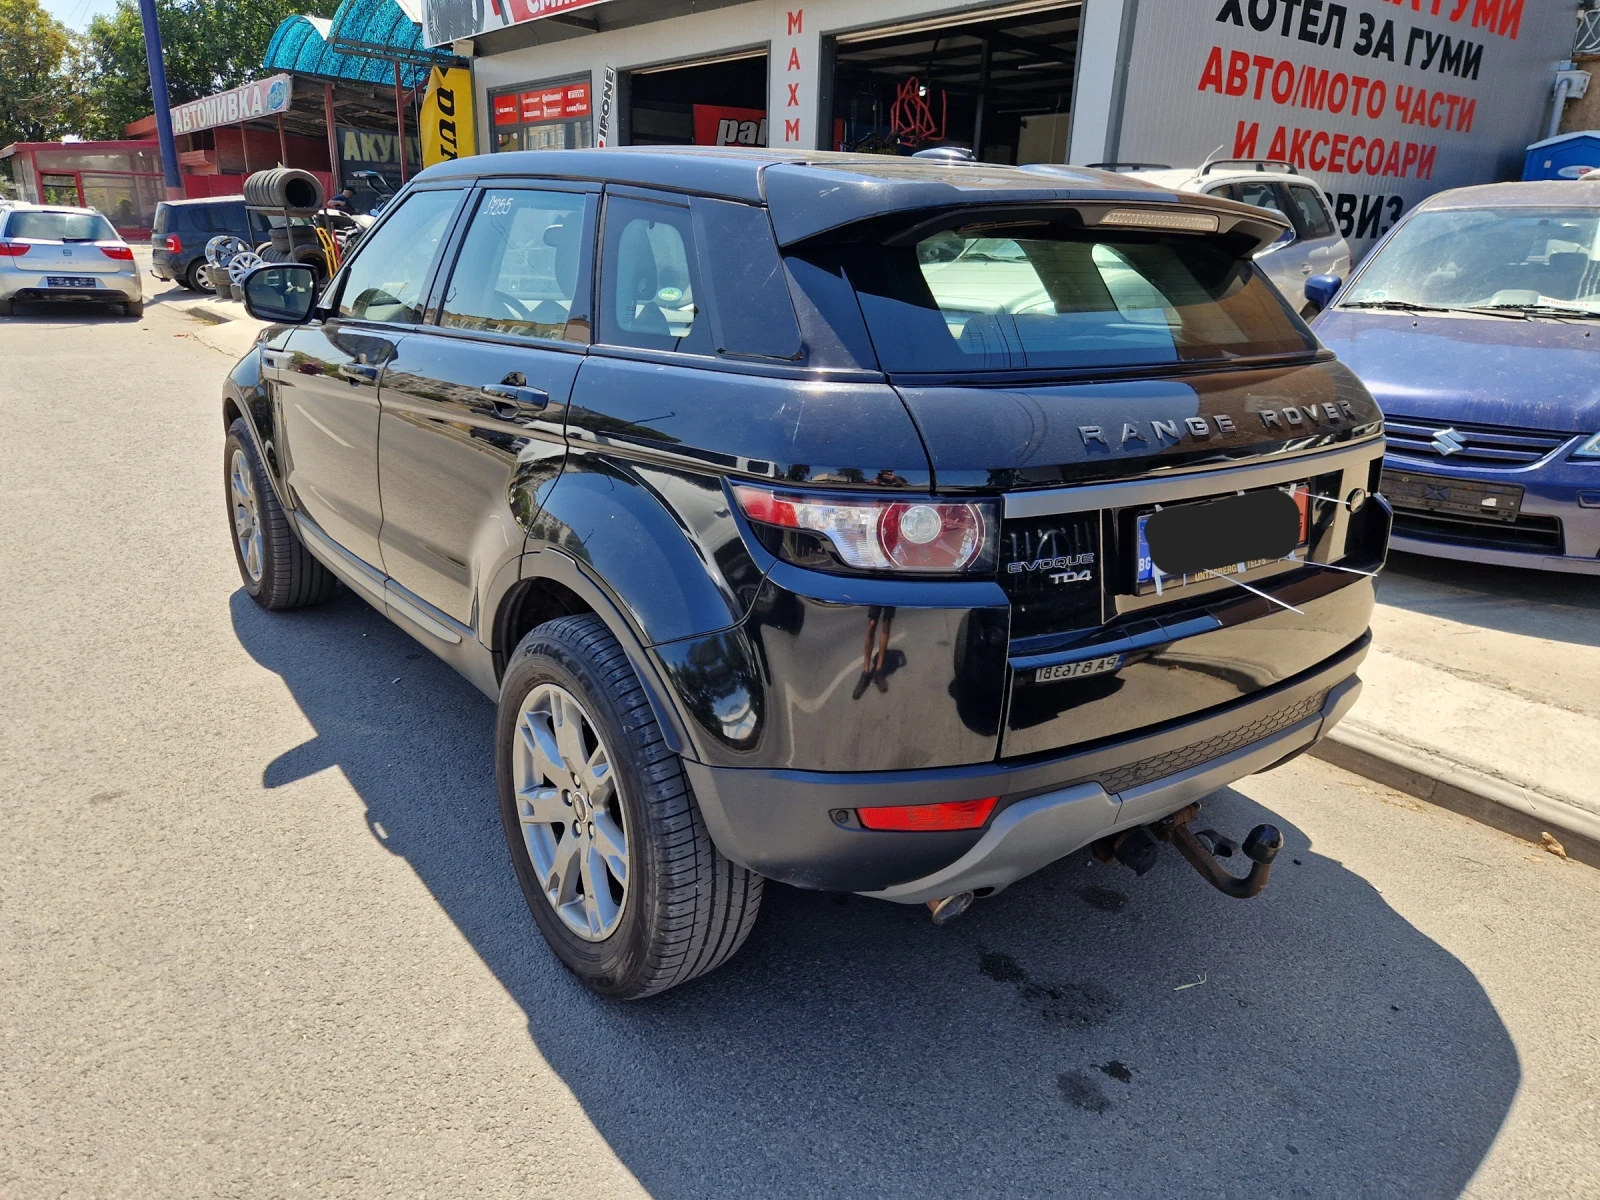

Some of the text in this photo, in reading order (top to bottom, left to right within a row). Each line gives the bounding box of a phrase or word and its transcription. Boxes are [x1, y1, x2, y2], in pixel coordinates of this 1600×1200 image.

[1216, 0, 1484, 80] ХОТЕЛ ЗА ГУМИ
[174, 85, 263, 133] АВТОМИВКА
[599, 68, 614, 138] IPONE
[1197, 46, 1476, 133] АВТО/МОТО ЧАСТИ
[1232, 120, 1437, 180] И АКСЕСОАРИ
[1077, 400, 1357, 446] RANGE ROVER
[1007, 552, 1094, 574] EVOQUE
[1049, 569, 1092, 584] TD4
[1138, 556, 1151, 572] BG
